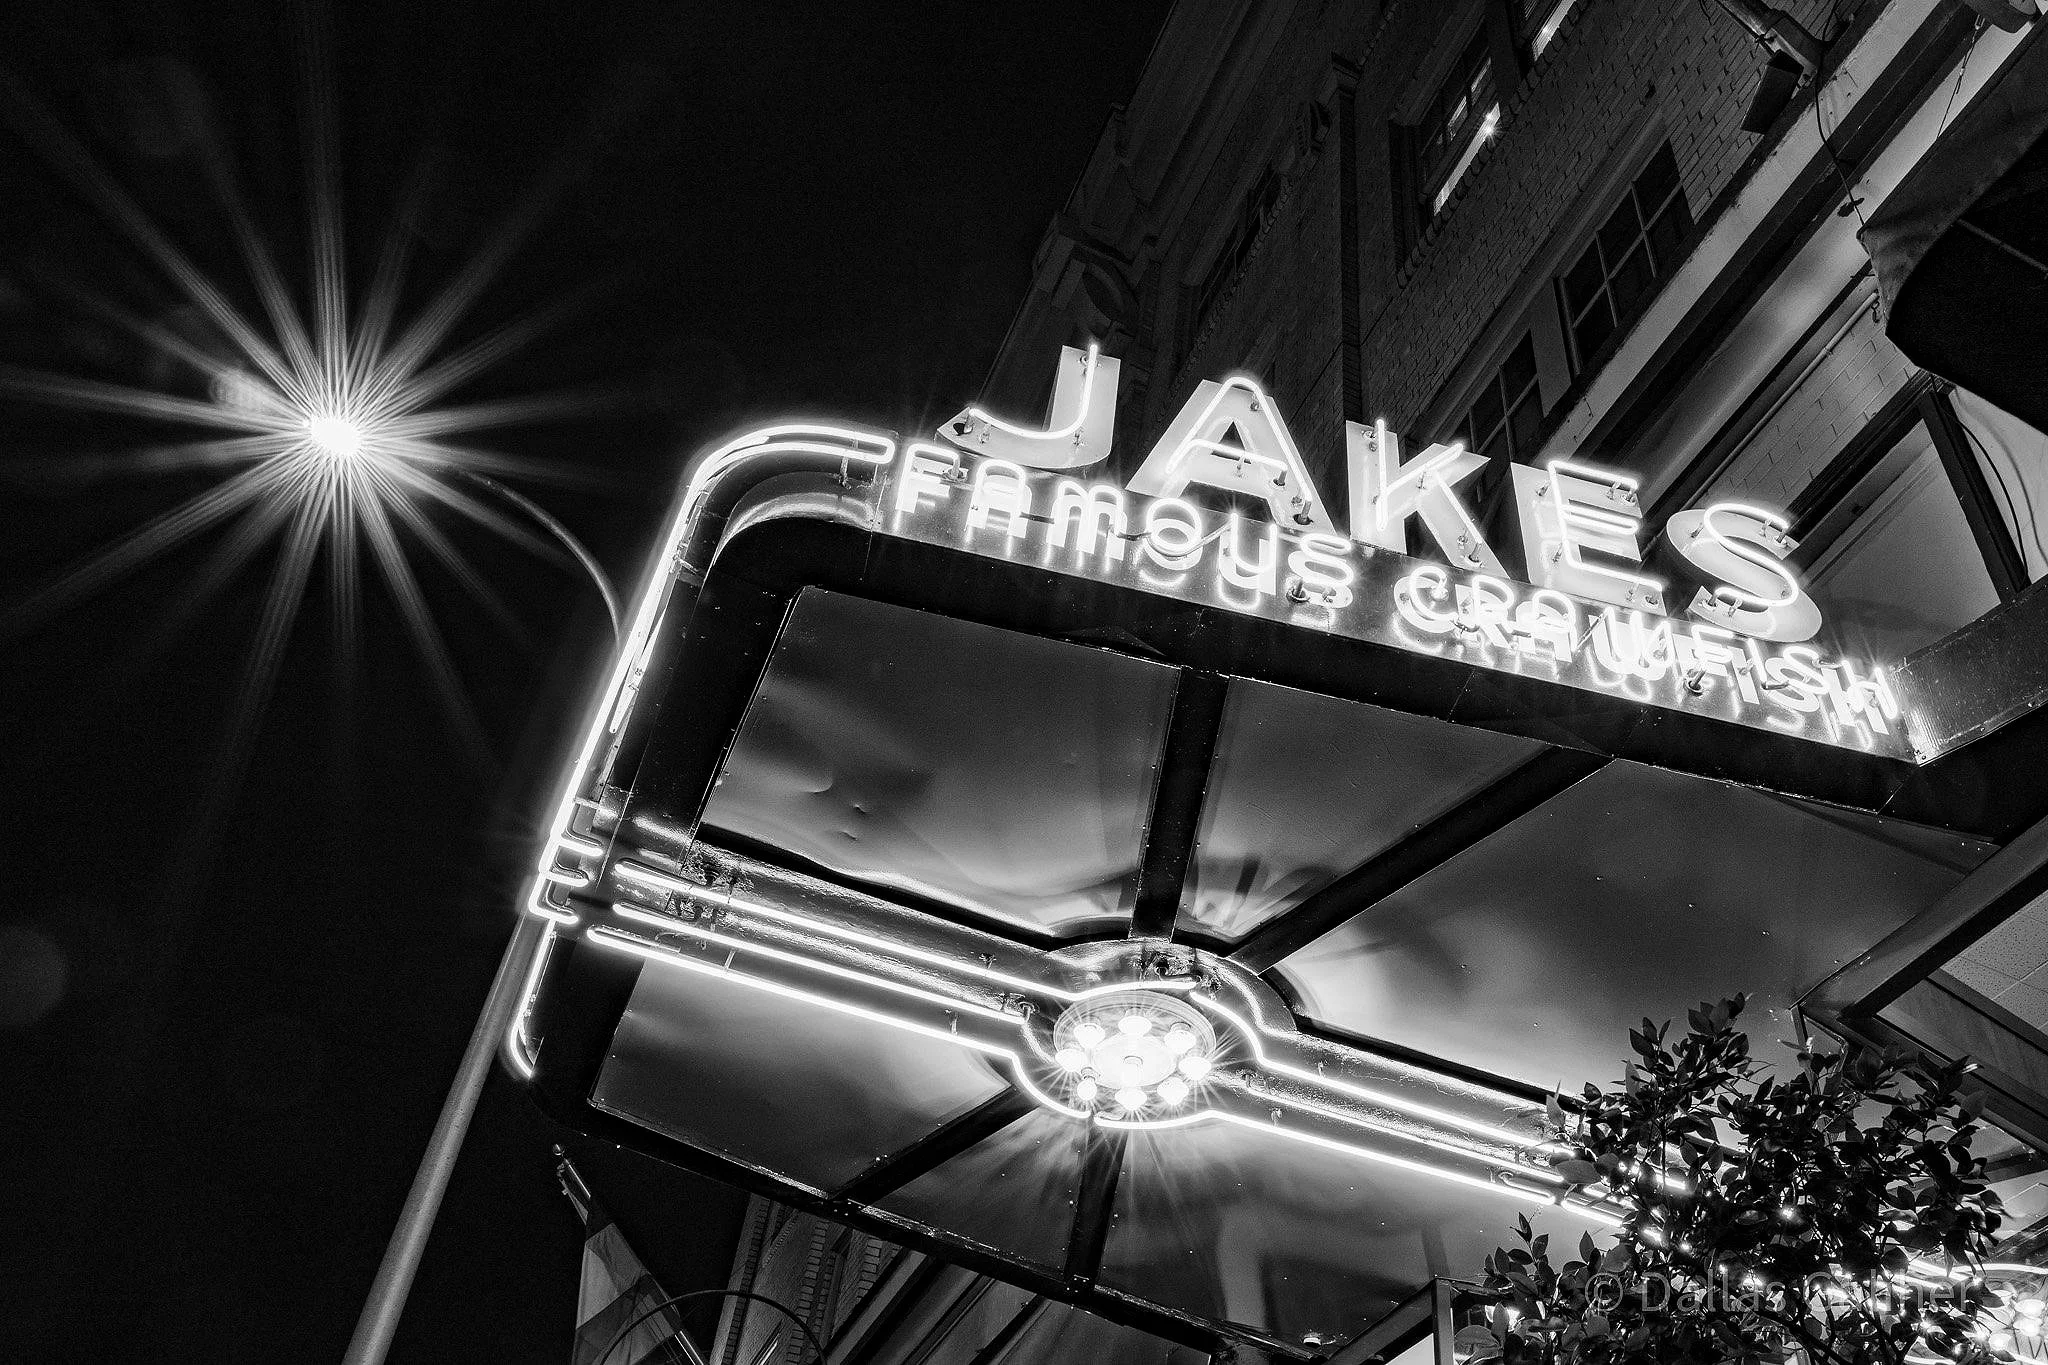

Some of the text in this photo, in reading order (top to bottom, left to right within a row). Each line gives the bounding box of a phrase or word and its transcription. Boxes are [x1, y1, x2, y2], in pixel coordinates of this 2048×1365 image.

[894, 443, 1898, 736] FAMOUS CRAWFISH
[935, 344, 1822, 642] JAKES
